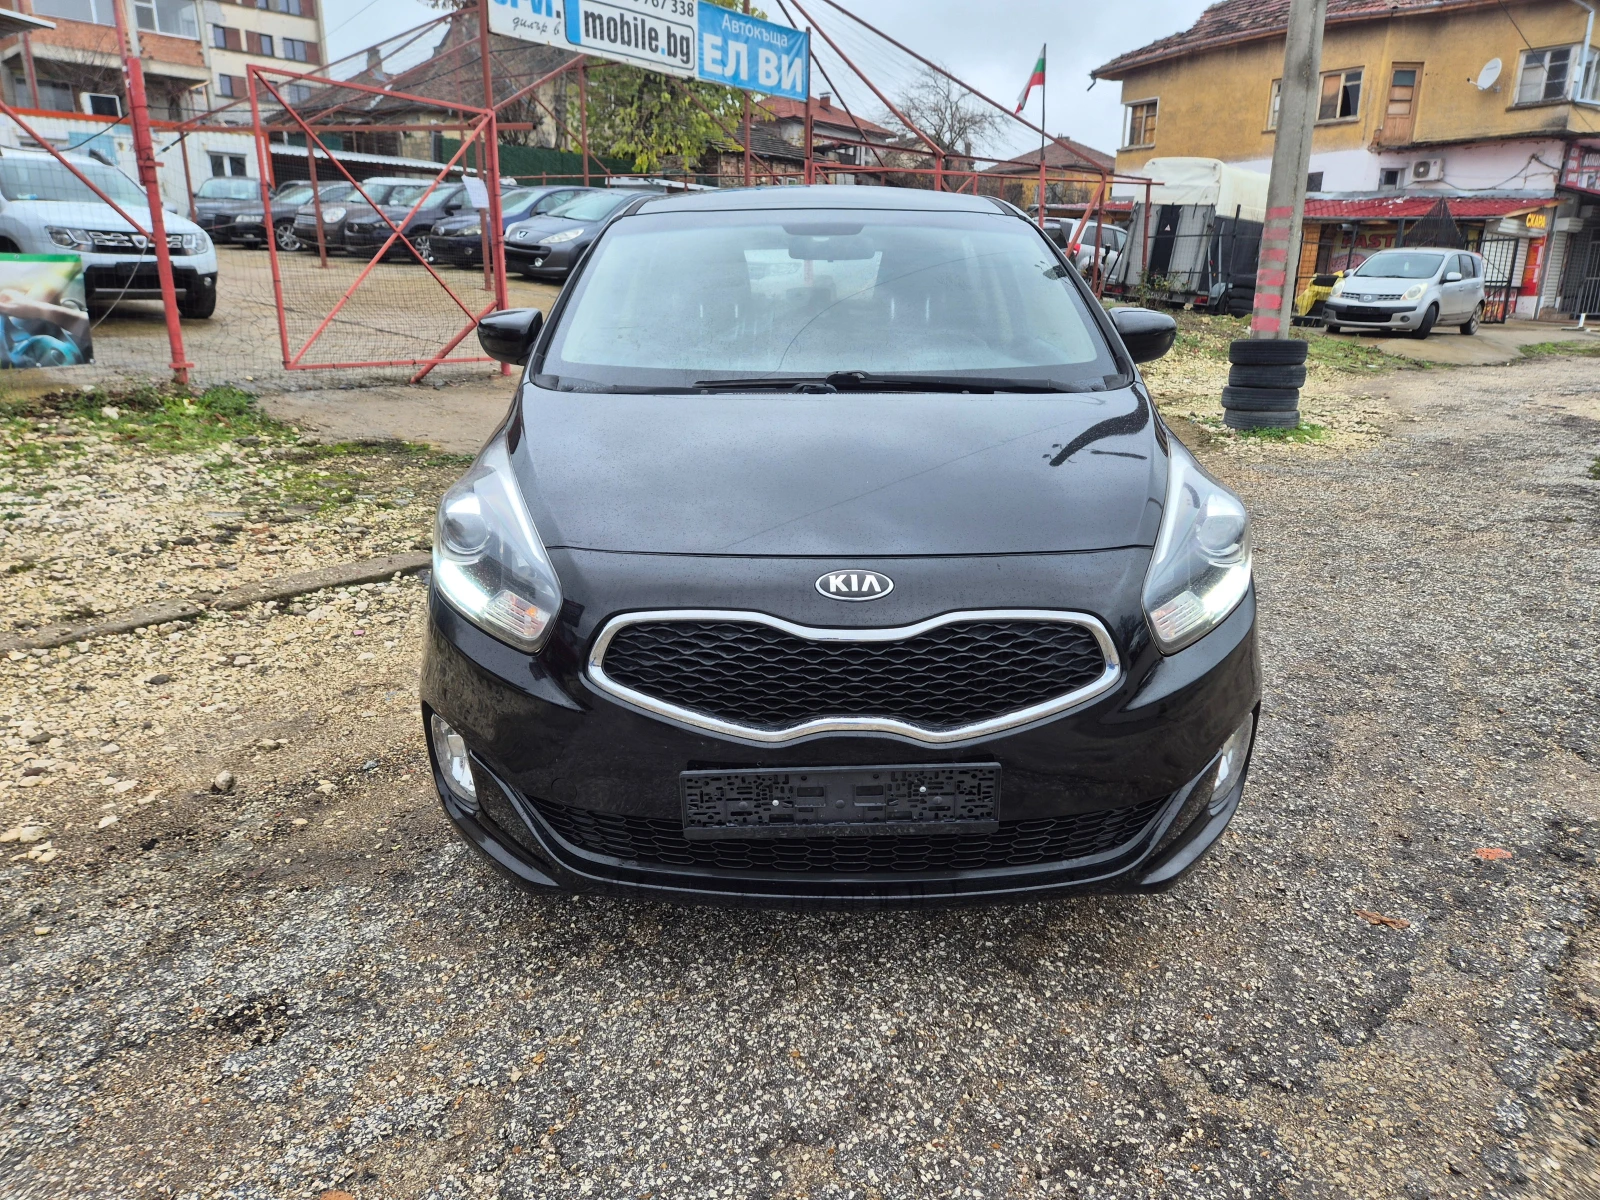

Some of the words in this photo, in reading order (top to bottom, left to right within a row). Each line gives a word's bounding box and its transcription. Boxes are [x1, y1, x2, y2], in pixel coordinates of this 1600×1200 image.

[671, 0, 694, 17] 338
[584, 10, 690, 64] mobile.bg
[722, 13, 788, 48] Автокъща
[703, 32, 748, 80] ЕЛ
[758, 47, 802, 93] ВИ
[828, 574, 882, 592] KIA
